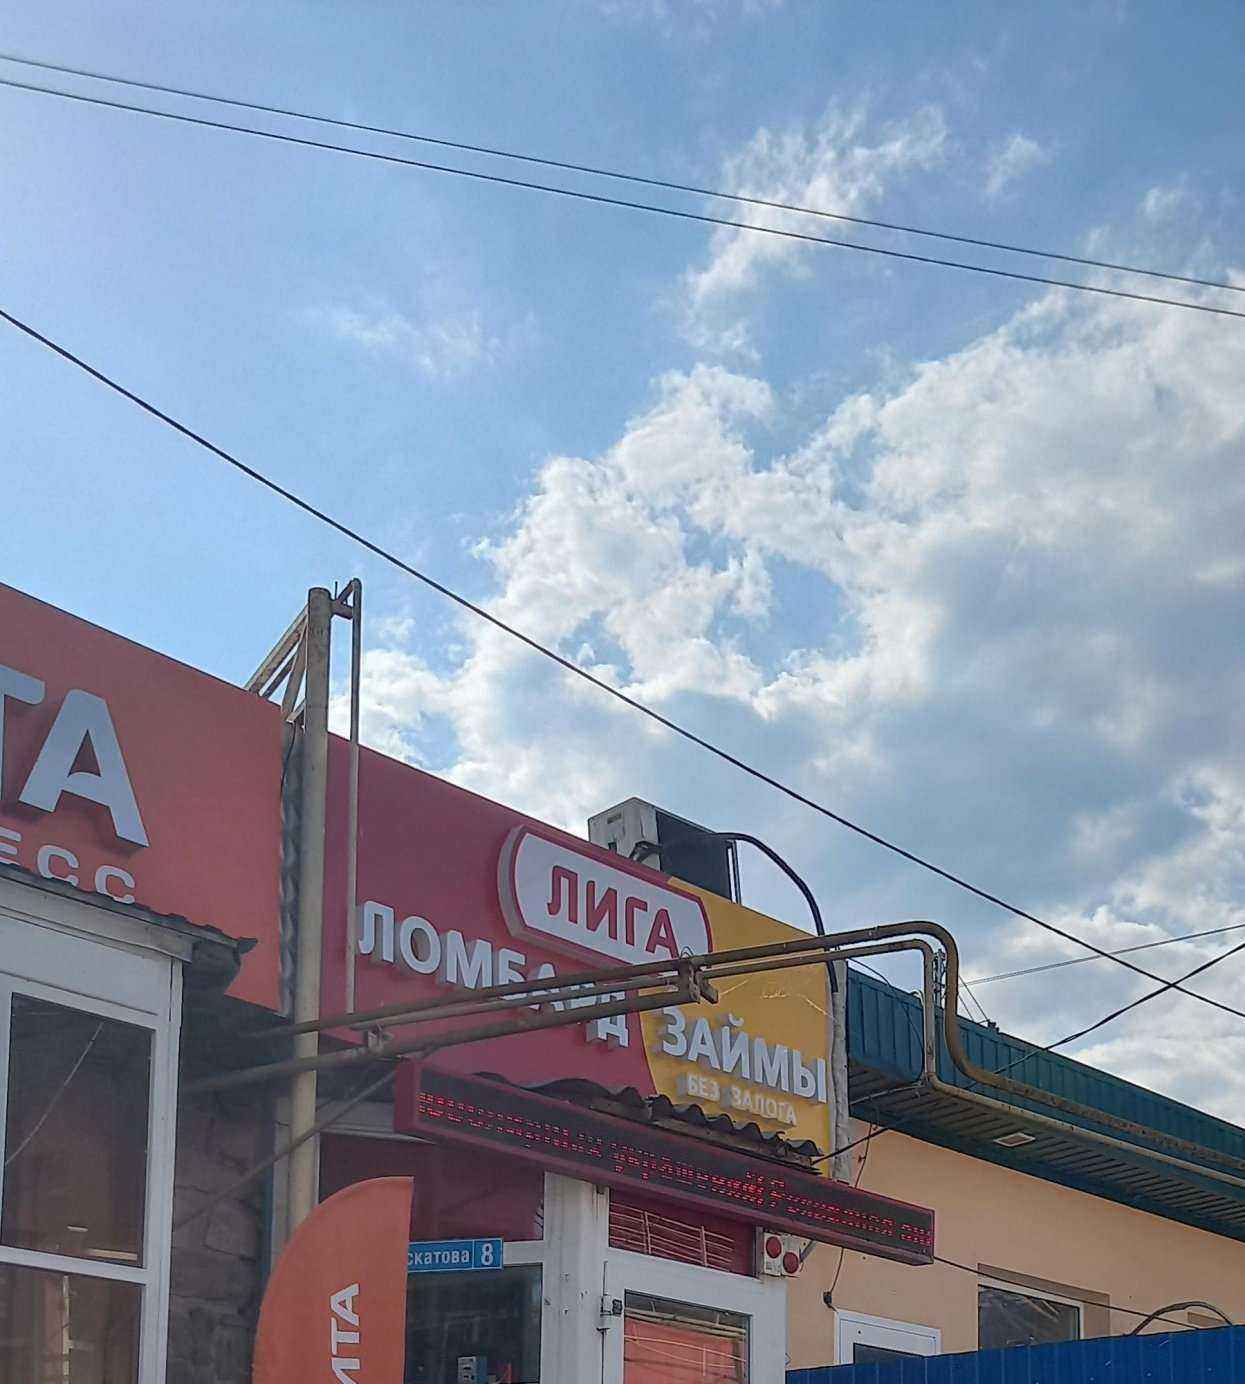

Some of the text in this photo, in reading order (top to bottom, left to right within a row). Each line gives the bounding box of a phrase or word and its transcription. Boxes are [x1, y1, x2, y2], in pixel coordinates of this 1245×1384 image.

[547, 865, 679, 960] ЛИГА
[662, 1005, 827, 1104] ЗАЙМЫ
[687, 1072, 797, 1127] БЕЗ ЗАЛОГА
[480, 1243, 494, 1266] 8
